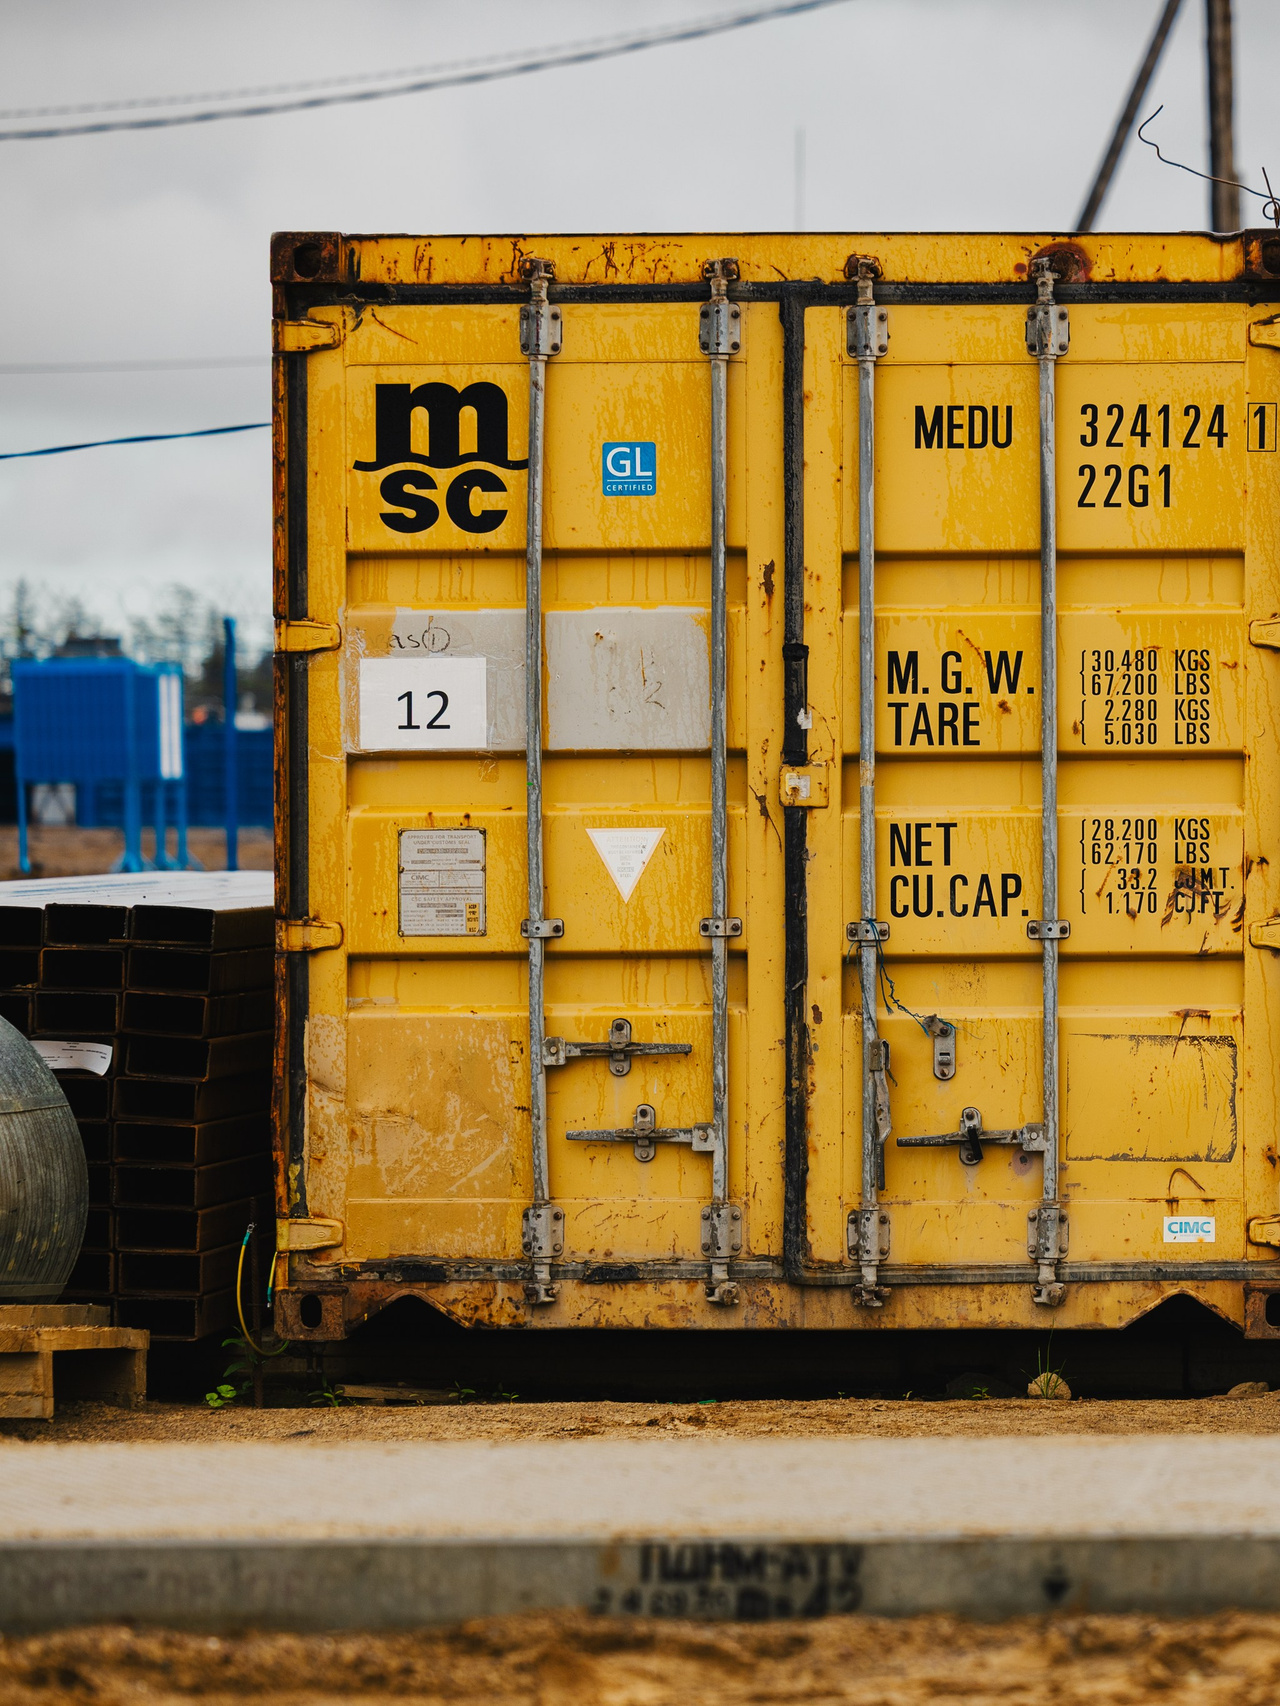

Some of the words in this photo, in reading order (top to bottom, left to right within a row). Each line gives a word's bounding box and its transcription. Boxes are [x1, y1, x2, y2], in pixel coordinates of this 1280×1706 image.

[914, 405, 1013, 449] MEDU
[1080, 403, 1228, 449] 324124
[1253, 406, 1266, 449] 1
[606, 447, 652, 477] GL
[606, 484, 653, 492] CERTIFIED
[1077, 464, 1171, 508] 22G1
[1092, 650, 1157, 672] 30,480
[1175, 650, 1210, 671] KGS
[1092, 673, 1157, 695] 67,200
[1175, 673, 1210, 695] LBS
[397, 690, 451, 730] 12
[1105, 699, 1157, 721] 2,280
[1175, 699, 1210, 721] KGS
[888, 702, 981, 746] TARE
[1105, 723, 1157, 745] 5,030
[1175, 722, 1210, 744] LBS
[1092, 819, 1157, 841] 28,200
[1175, 818, 1210, 840] KGS
[890, 822, 957, 866] NET
[1092, 842, 1157, 864] 62,170
[1175, 842, 1210, 864] LBS
[1118, 868, 1157, 890] 33.2
[890, 874, 1029, 917] CU.CAP.
[1106, 891, 1157, 914] 1,170
[1167, 1221, 1211, 1234] CIMC
